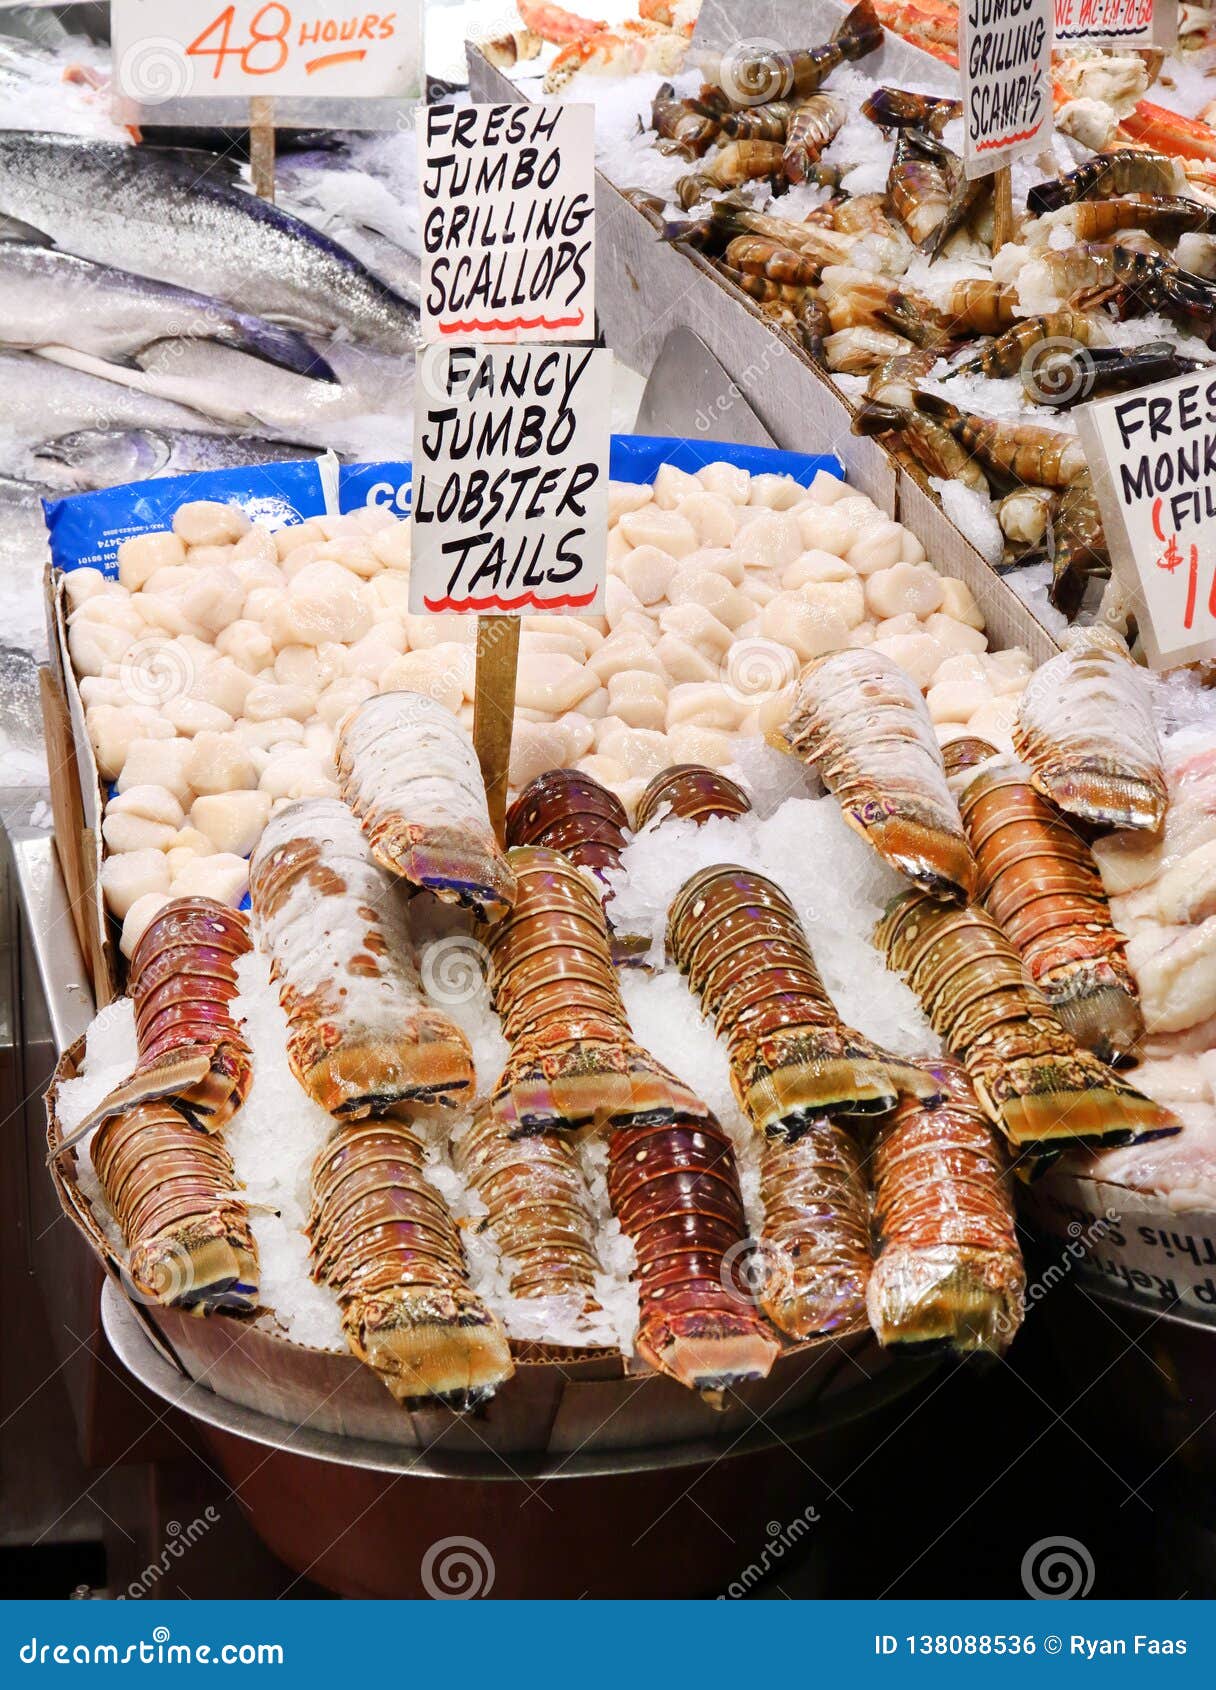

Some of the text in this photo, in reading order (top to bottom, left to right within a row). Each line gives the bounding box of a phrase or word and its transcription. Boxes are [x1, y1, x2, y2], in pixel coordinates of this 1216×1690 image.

[185, 2, 397, 80] 48 HOURS
[969, 16, 1046, 80] GRILLING
[426, 104, 564, 149] FRESH
[423, 147, 561, 199] JUMBO
[424, 193, 595, 253] GRILLING
[426, 241, 592, 316] SCALLOPS
[446, 347, 594, 413] FANCY
[421, 405, 576, 461] JUMBO
[415, 462, 599, 530] LOBSTER
[441, 527, 586, 597] TAILS
